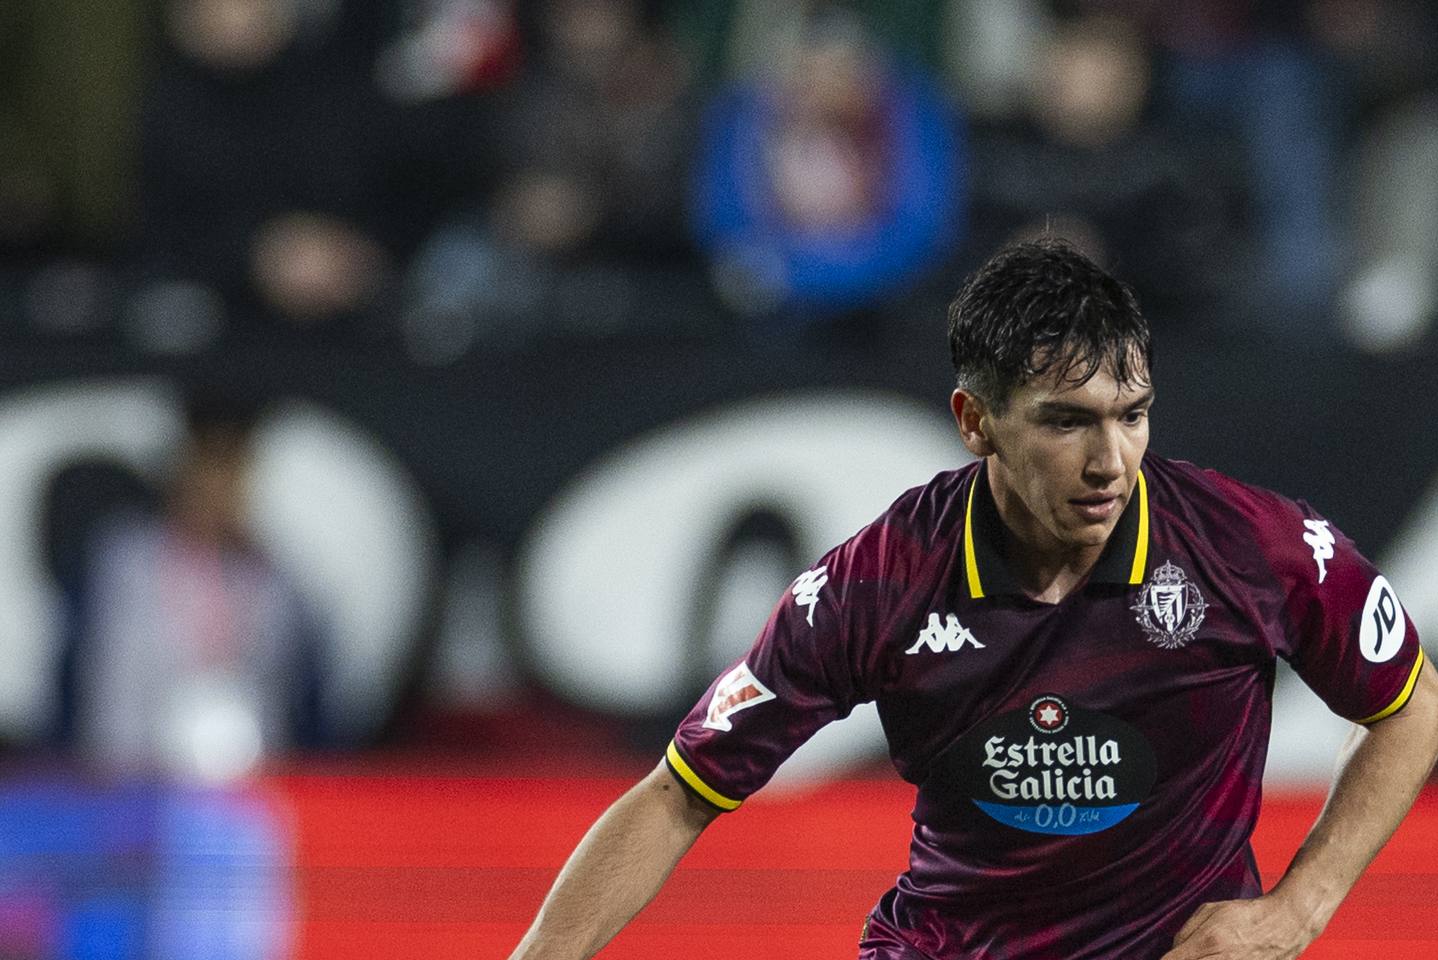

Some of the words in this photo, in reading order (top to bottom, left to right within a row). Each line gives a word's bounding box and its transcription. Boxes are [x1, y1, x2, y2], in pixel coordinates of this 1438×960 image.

[1372, 586, 1397, 656] JD
[981, 735, 1122, 769] Estrella
[989, 768, 1118, 801] Galicia
[1033, 802, 1077, 829] 0,0
